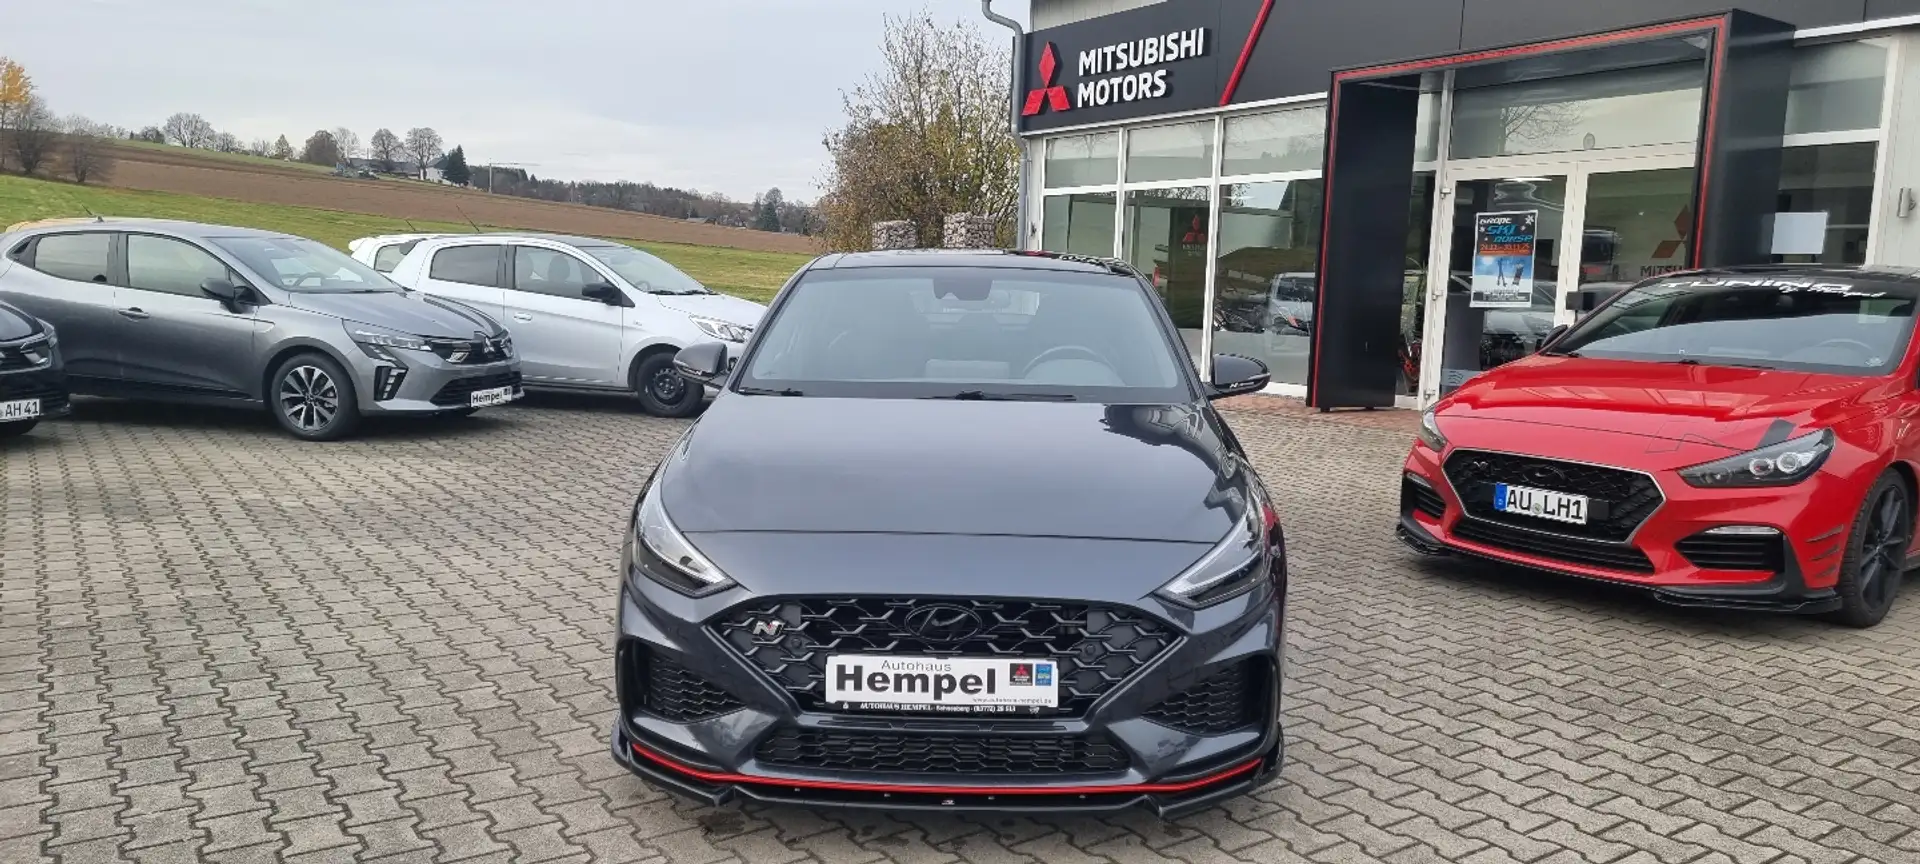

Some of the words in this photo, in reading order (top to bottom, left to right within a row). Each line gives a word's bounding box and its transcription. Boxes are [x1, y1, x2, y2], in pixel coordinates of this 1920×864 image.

[1078, 27, 1204, 76] MITSUBISHI
[1077, 69, 1167, 108] MOTORS
[5, 403, 21, 416] AH
[24, 401, 39, 414] 41
[1507, 489, 1532, 511] AU
[1544, 494, 1583, 520] LH1
[881, 660, 952, 672] Autohaus
[836, 664, 996, 701] Hempel
[860, 702, 900, 711] AUTOHAUS
